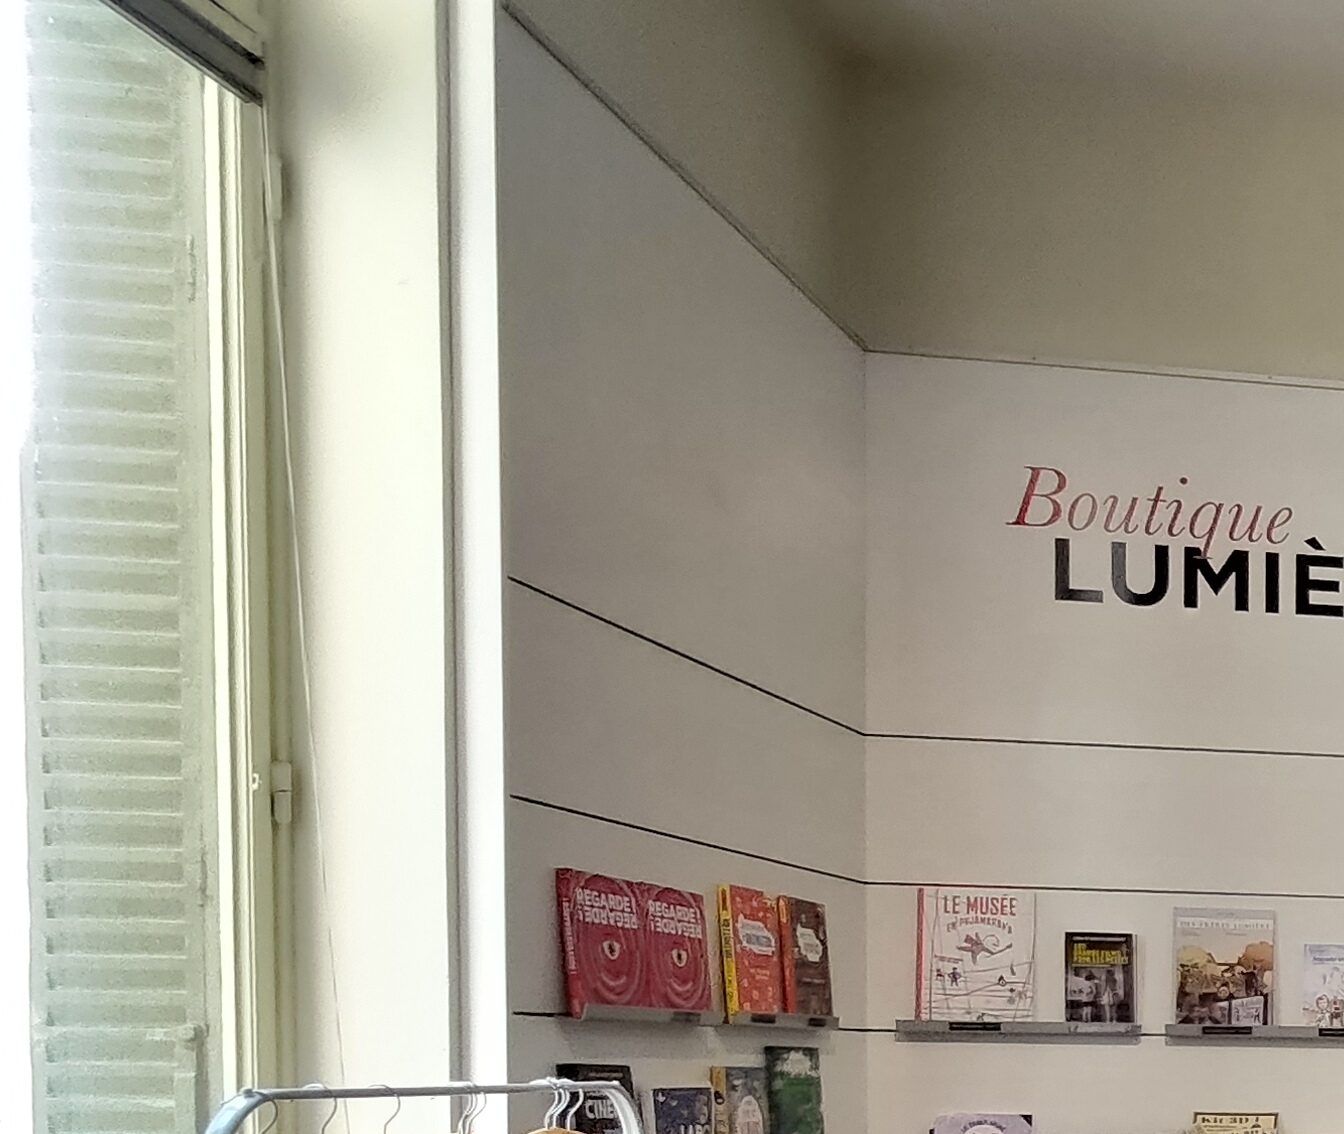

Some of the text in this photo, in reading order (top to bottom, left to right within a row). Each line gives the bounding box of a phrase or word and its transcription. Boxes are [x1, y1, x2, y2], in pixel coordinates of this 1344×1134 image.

[1005, 465, 1293, 560] Boutique
[944, 893, 1017, 916] LE MUSÉE
